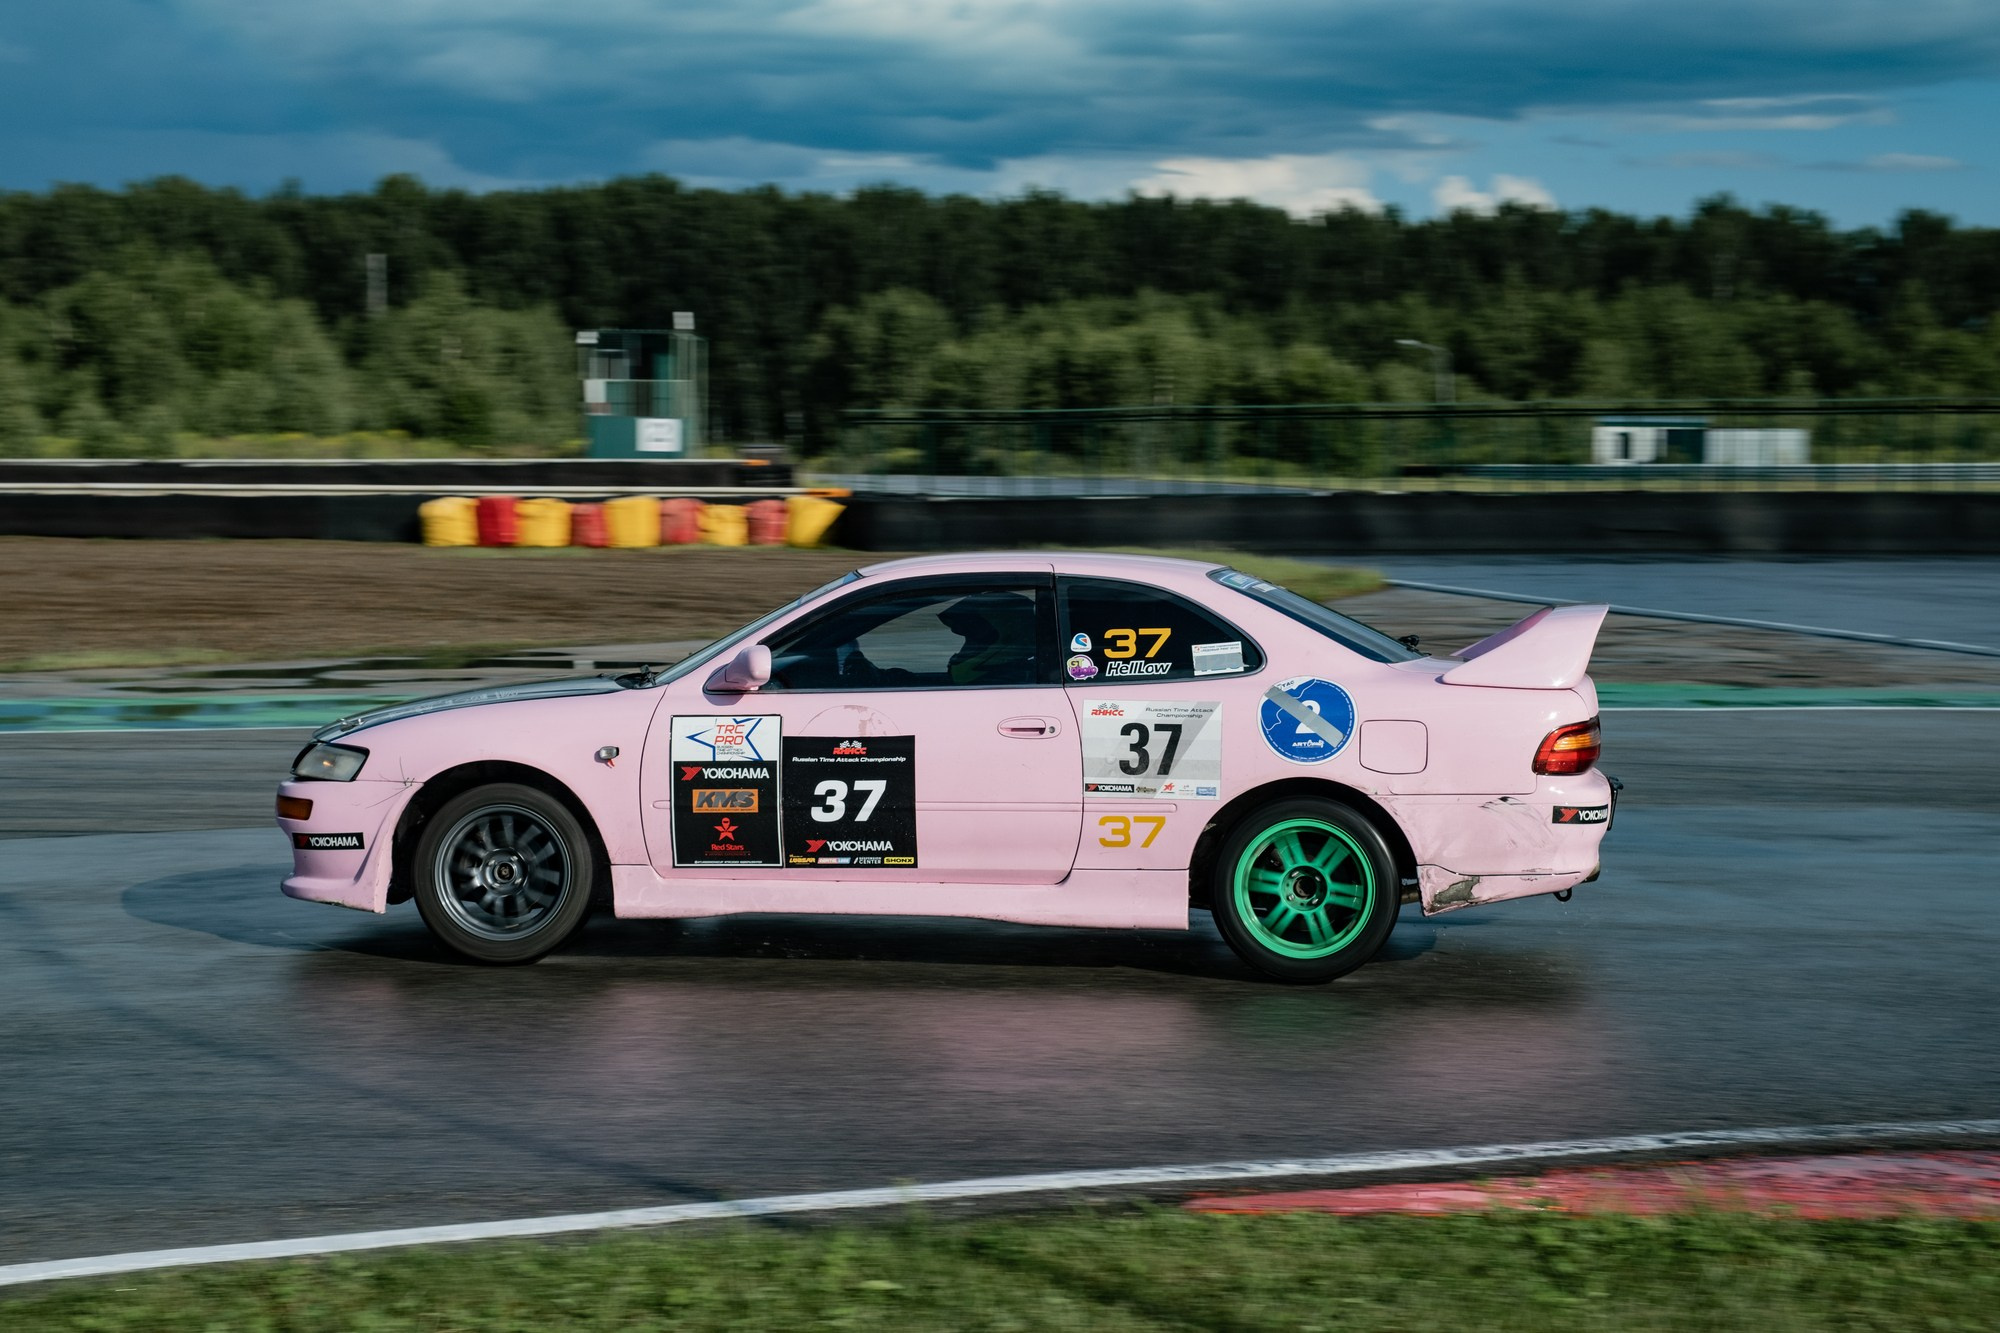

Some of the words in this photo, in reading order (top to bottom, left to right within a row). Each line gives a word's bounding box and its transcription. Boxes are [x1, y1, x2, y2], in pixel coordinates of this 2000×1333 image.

[1104, 628, 1171, 658] 37
[716, 724, 745, 734] TRC
[714, 736, 744, 746] PRO
[1118, 722, 1182, 776] 37
[702, 768, 770, 780] YOKOHAMA
[696, 791, 754, 808] KMS
[810, 780, 886, 822] 37
[1098, 816, 1166, 848] 37
[309, 836, 359, 846] YOKOHAMA
[826, 840, 894, 851] YOKOHAMA
